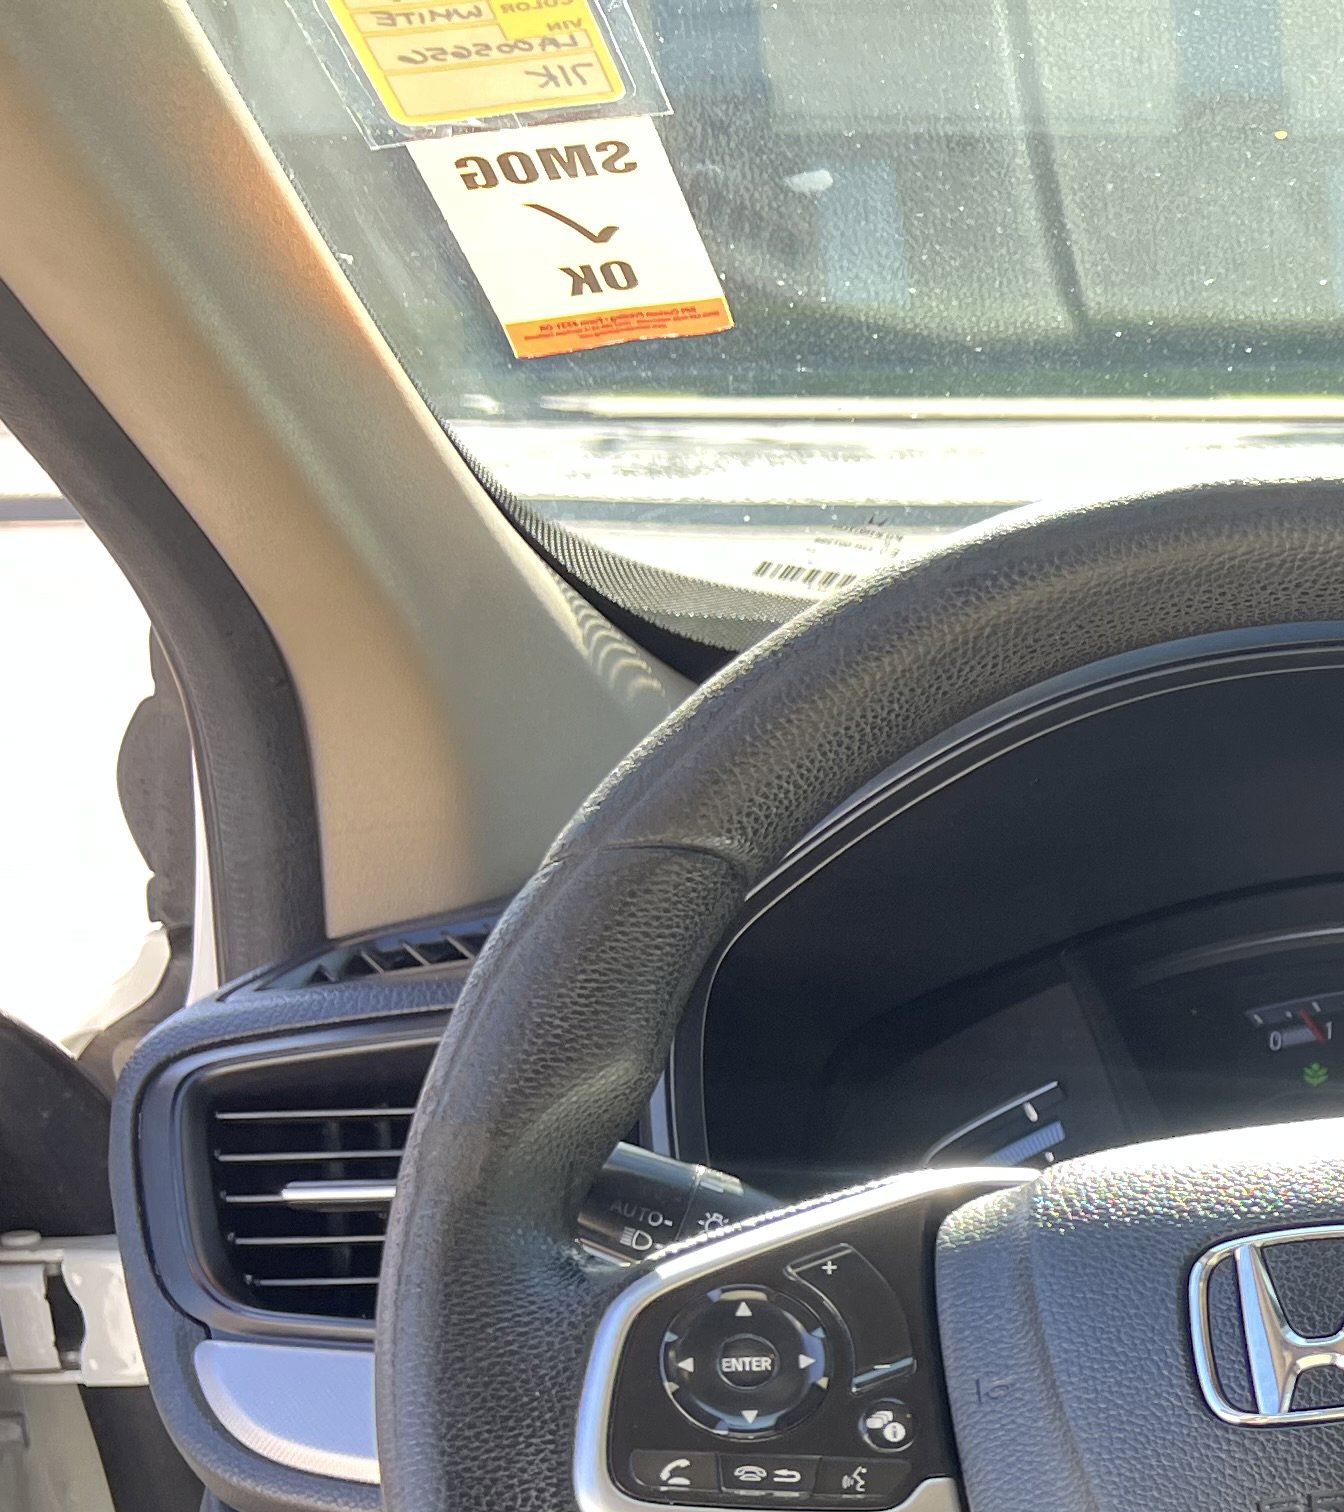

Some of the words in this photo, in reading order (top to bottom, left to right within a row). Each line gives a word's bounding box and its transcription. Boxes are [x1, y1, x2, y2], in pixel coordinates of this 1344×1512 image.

[1269, 1032, 1282, 1051] 0
[1326, 1023, 1333, 1041] 1
[608, 1200, 664, 1227] AUTO
[722, 1356, 772, 1372] ENTER
